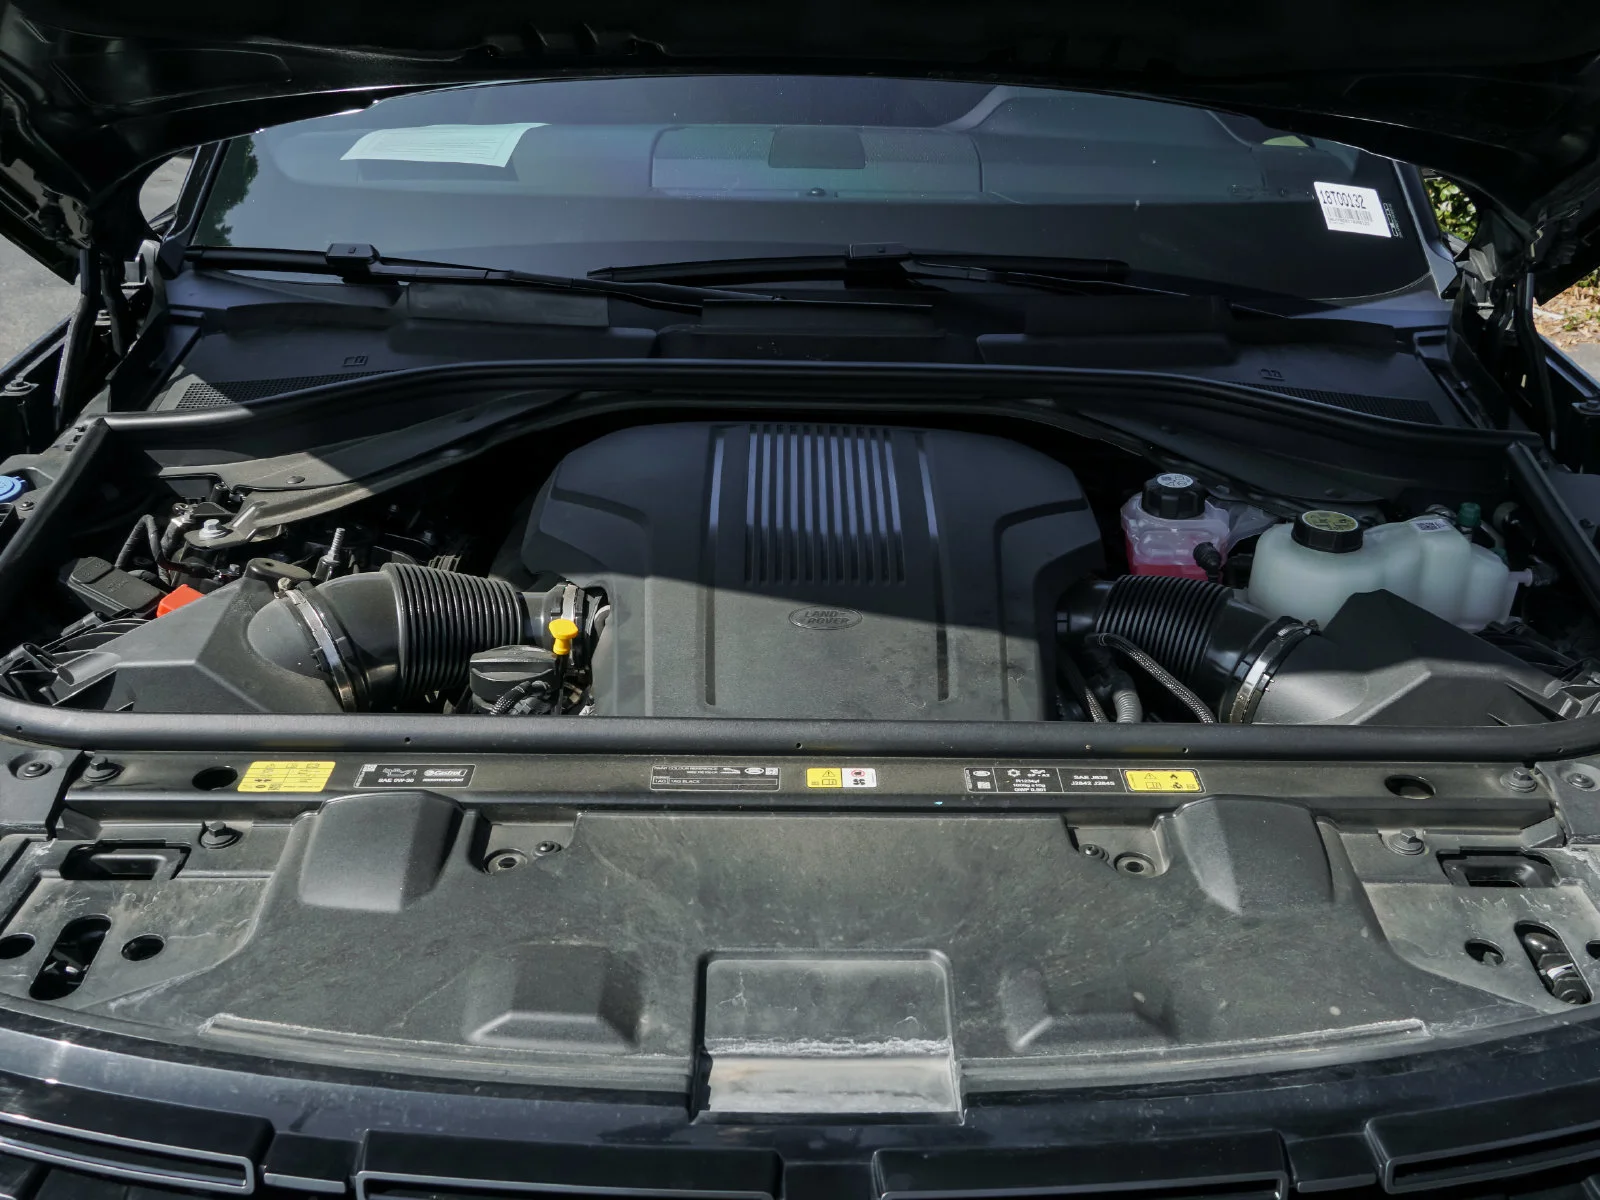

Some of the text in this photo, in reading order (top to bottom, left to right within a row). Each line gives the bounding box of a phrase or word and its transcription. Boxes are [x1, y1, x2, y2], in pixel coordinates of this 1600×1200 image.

[1320, 190, 1367, 209] 18T00132
[804, 609, 840, 618] LAND
[807, 617, 851, 625] ROVER
